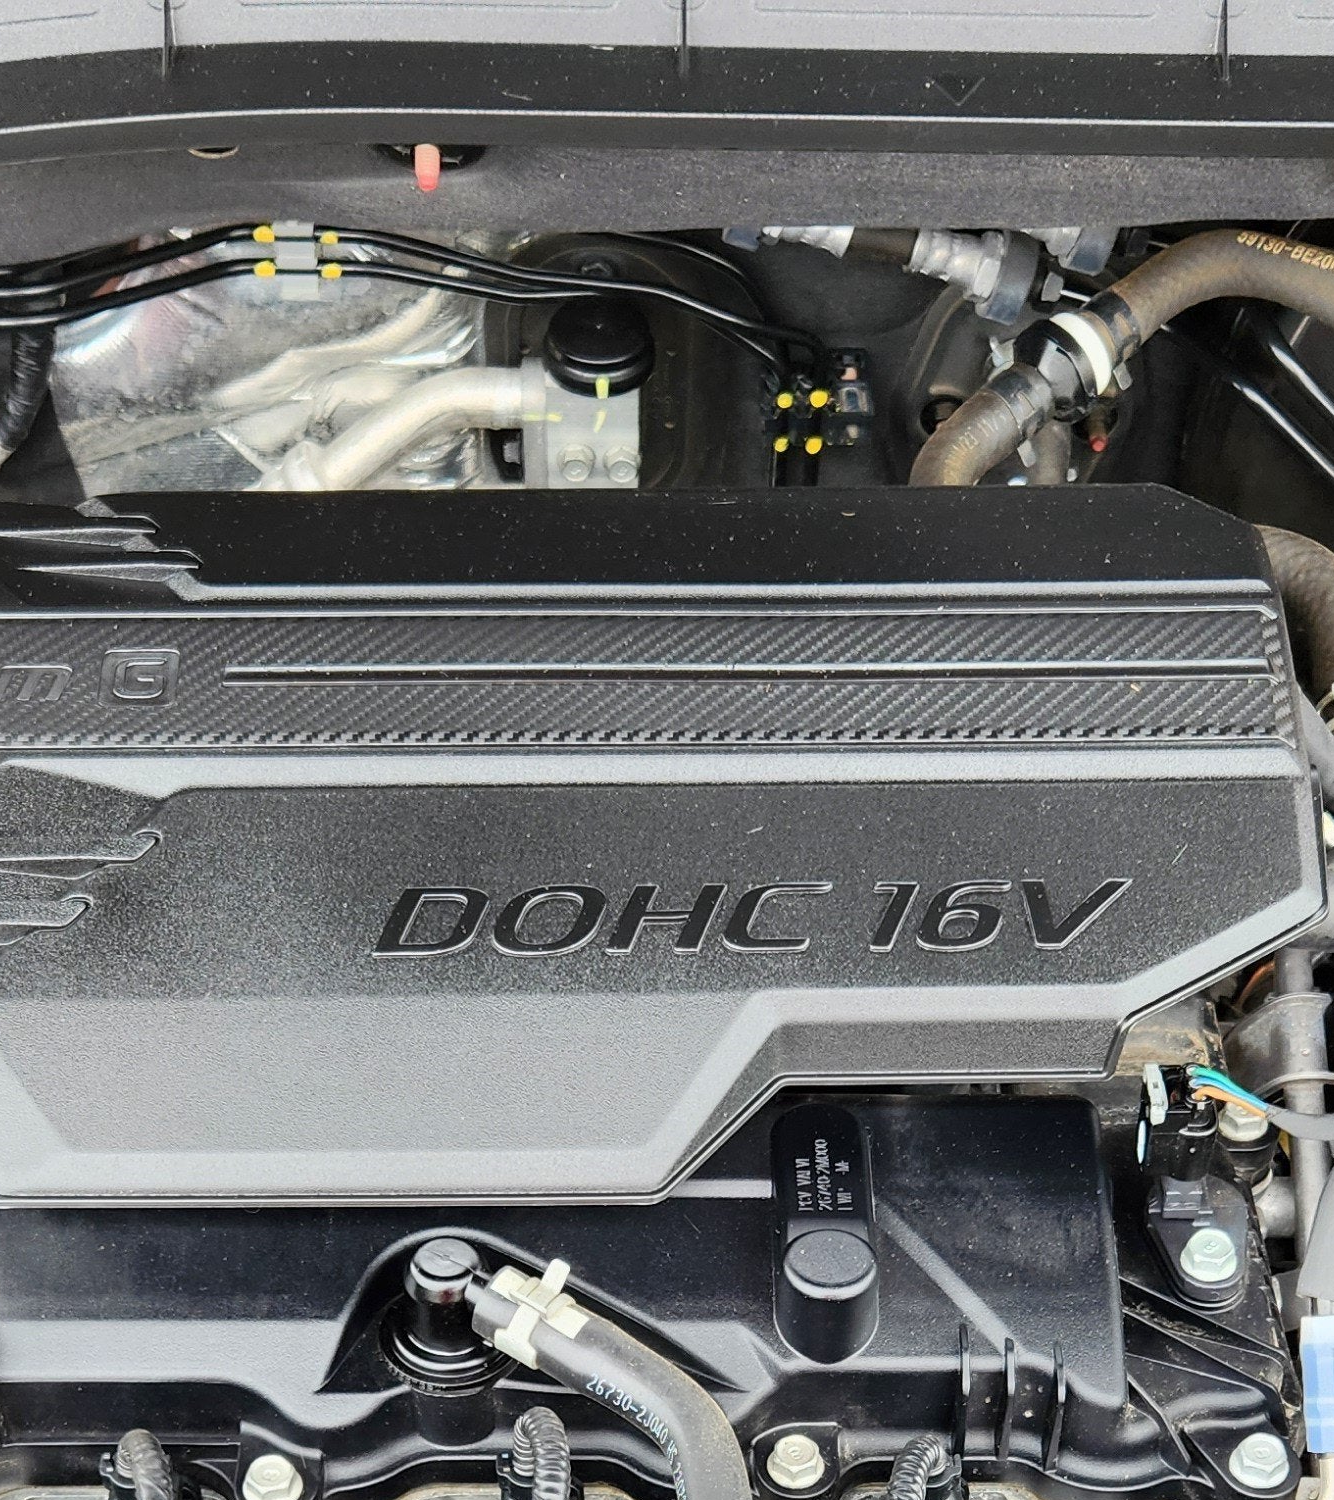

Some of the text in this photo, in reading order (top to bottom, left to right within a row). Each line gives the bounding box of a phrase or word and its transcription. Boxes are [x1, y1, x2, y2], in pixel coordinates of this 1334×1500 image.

[370, 877, 1135, 959] DOHC 16V
[585, 1373, 670, 1446] 26730-2J040
